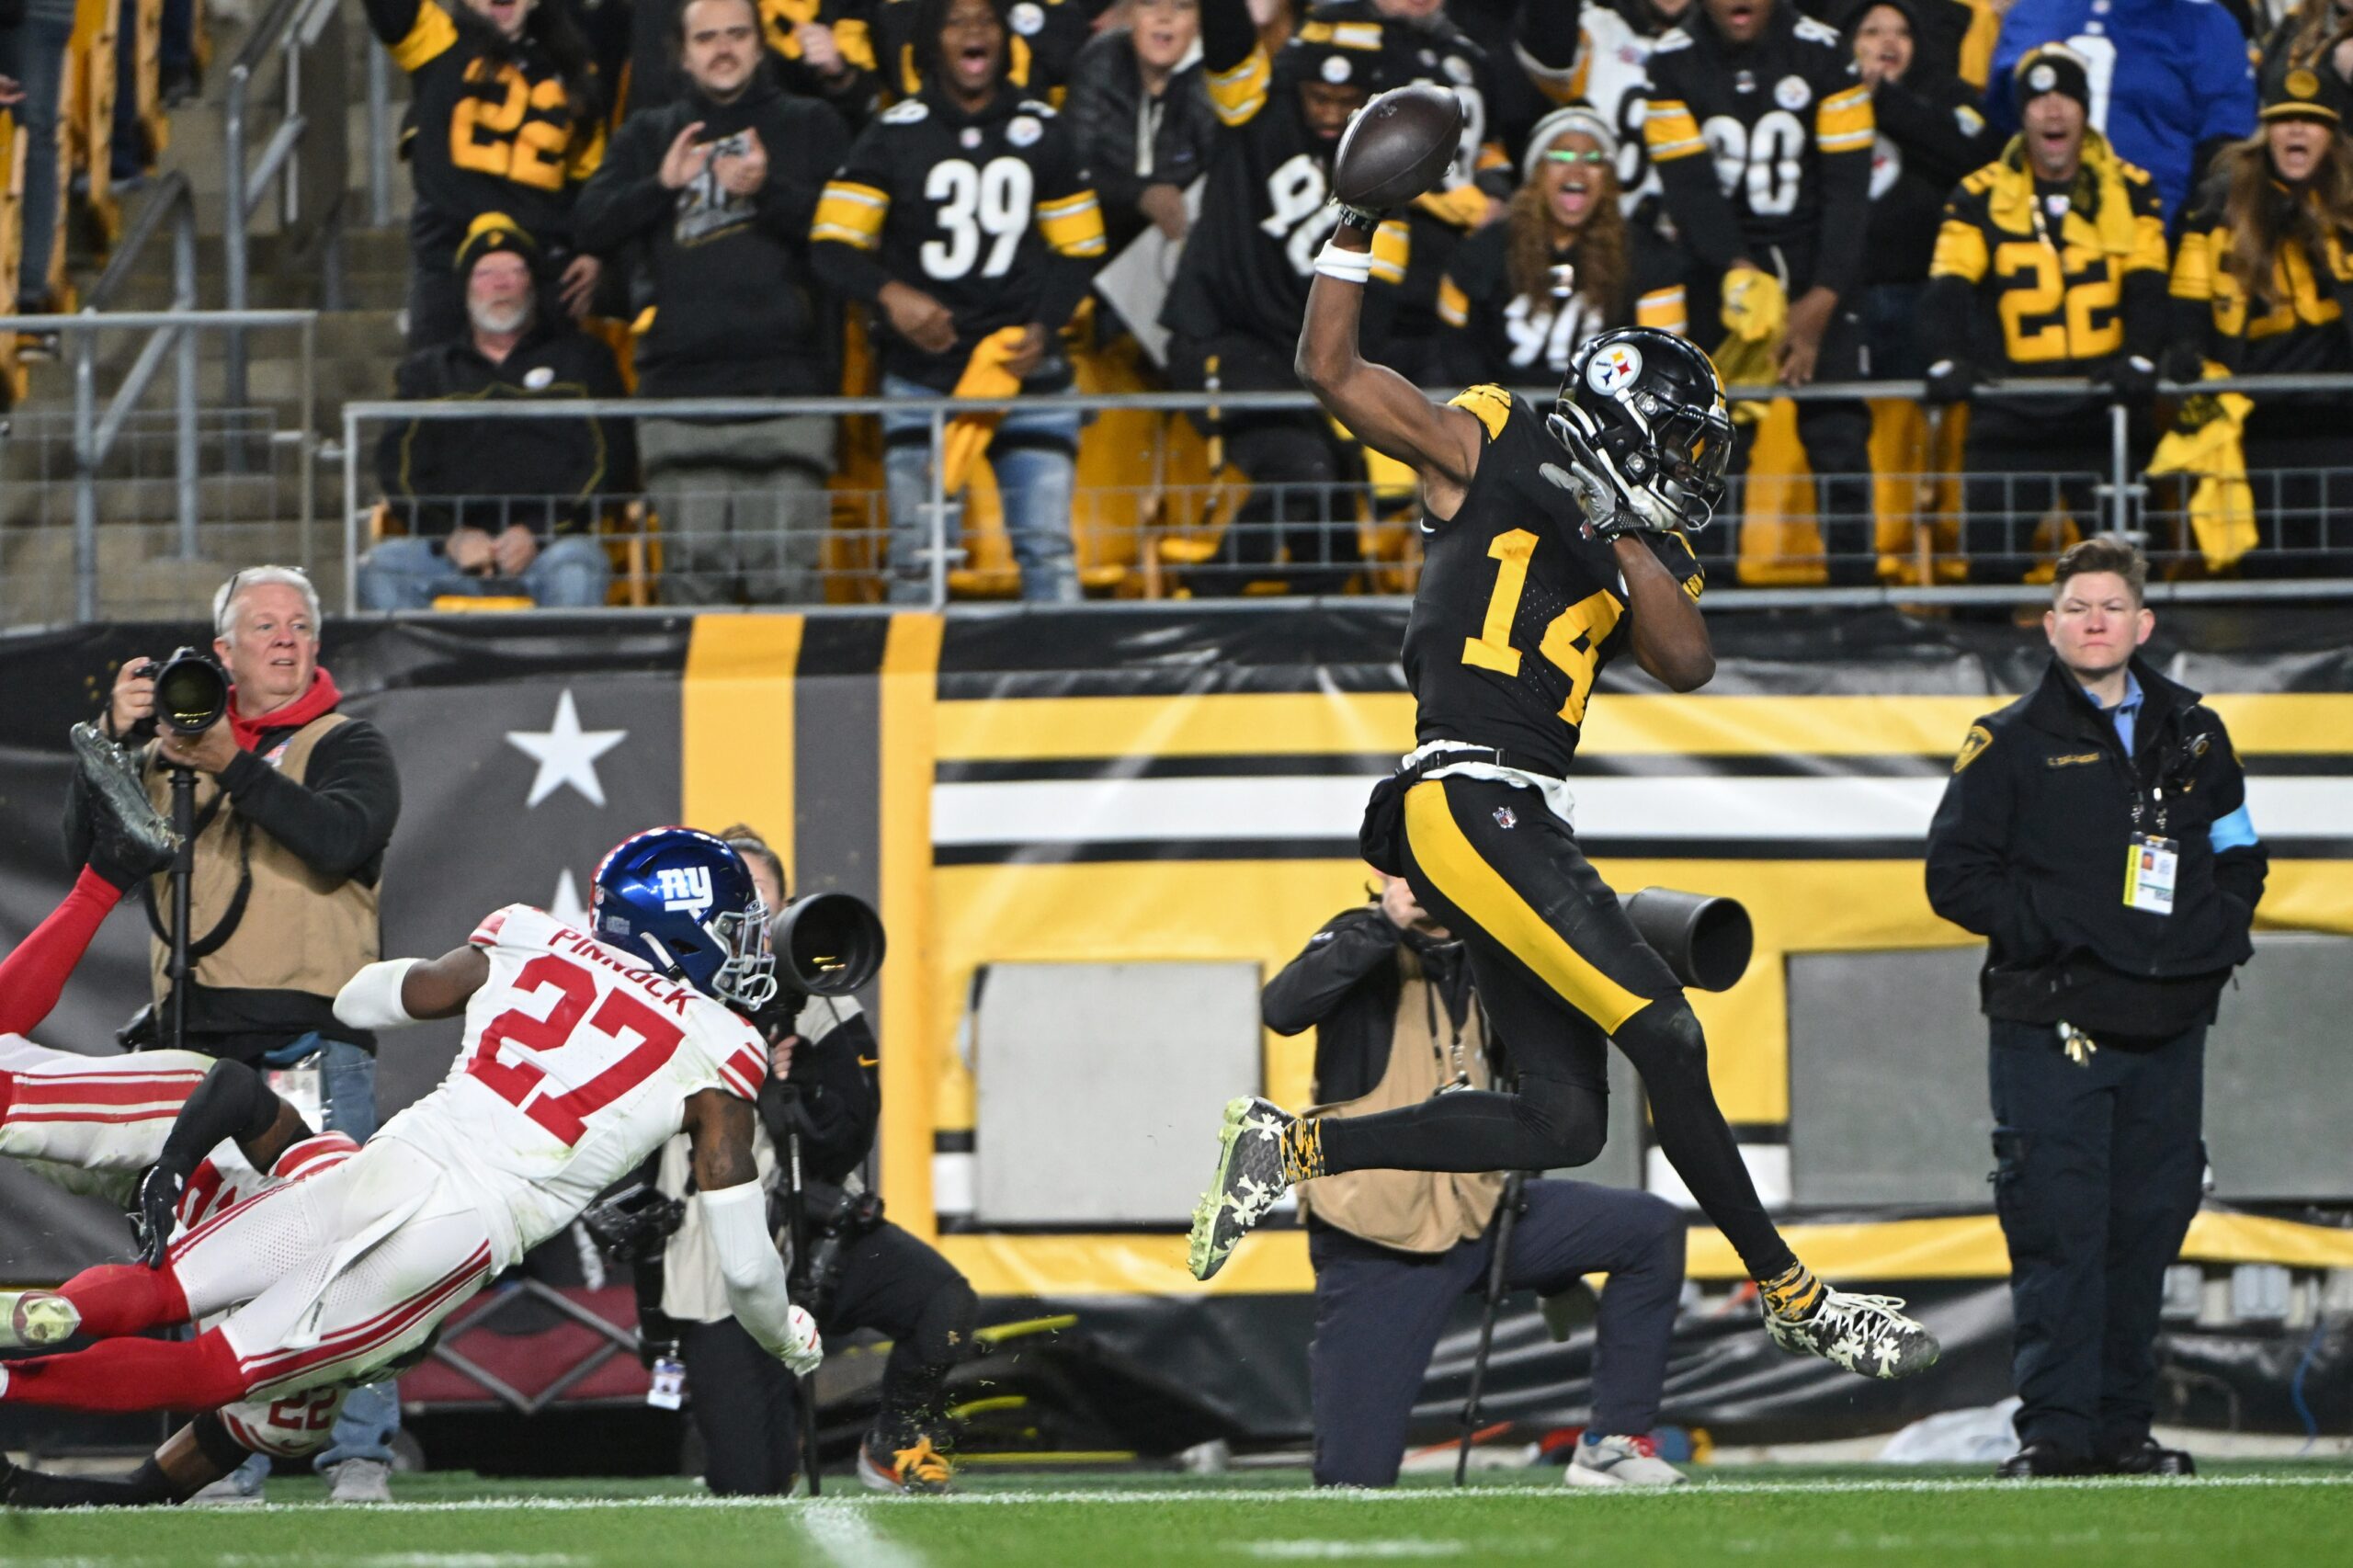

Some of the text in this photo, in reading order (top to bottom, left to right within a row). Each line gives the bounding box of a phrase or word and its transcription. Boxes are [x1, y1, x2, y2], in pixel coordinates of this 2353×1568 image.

[450, 57, 573, 190] 22
[920, 156, 1034, 279] 39
[1995, 242, 2125, 362] 22
[1461, 528, 1625, 727] 14
[466, 953, 686, 1147] 27
[267, 1389, 337, 1430] 22
